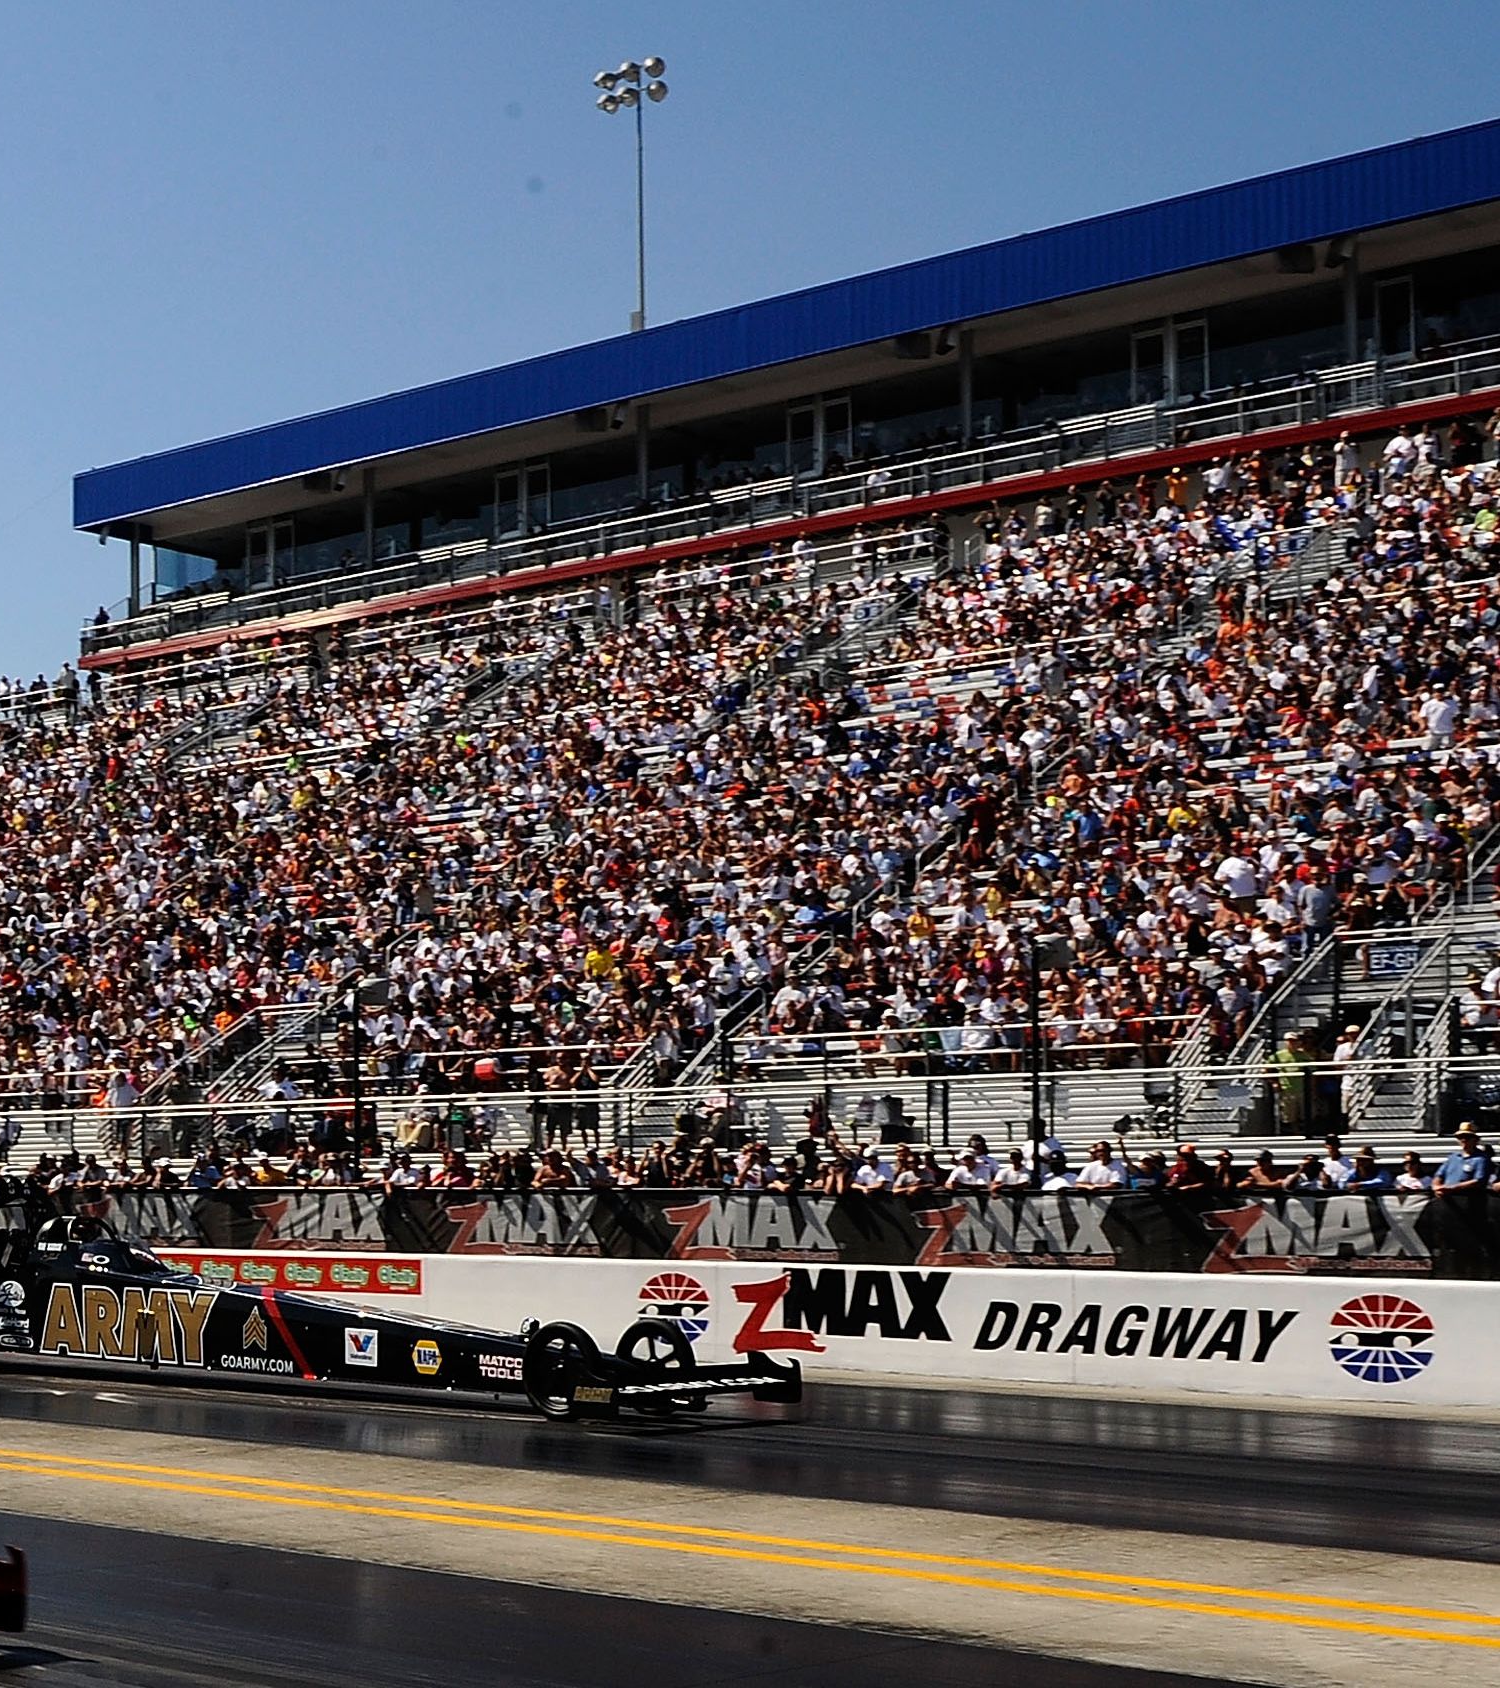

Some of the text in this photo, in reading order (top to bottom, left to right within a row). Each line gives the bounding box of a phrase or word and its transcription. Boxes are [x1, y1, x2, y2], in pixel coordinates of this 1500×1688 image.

[39, 1282, 221, 1367] ARMY
[973, 1300, 1300, 1364] DRAGWAY
[221, 1354, 294, 1374] GOARMY.COM
[479, 1366, 523, 1381] TOOLS
